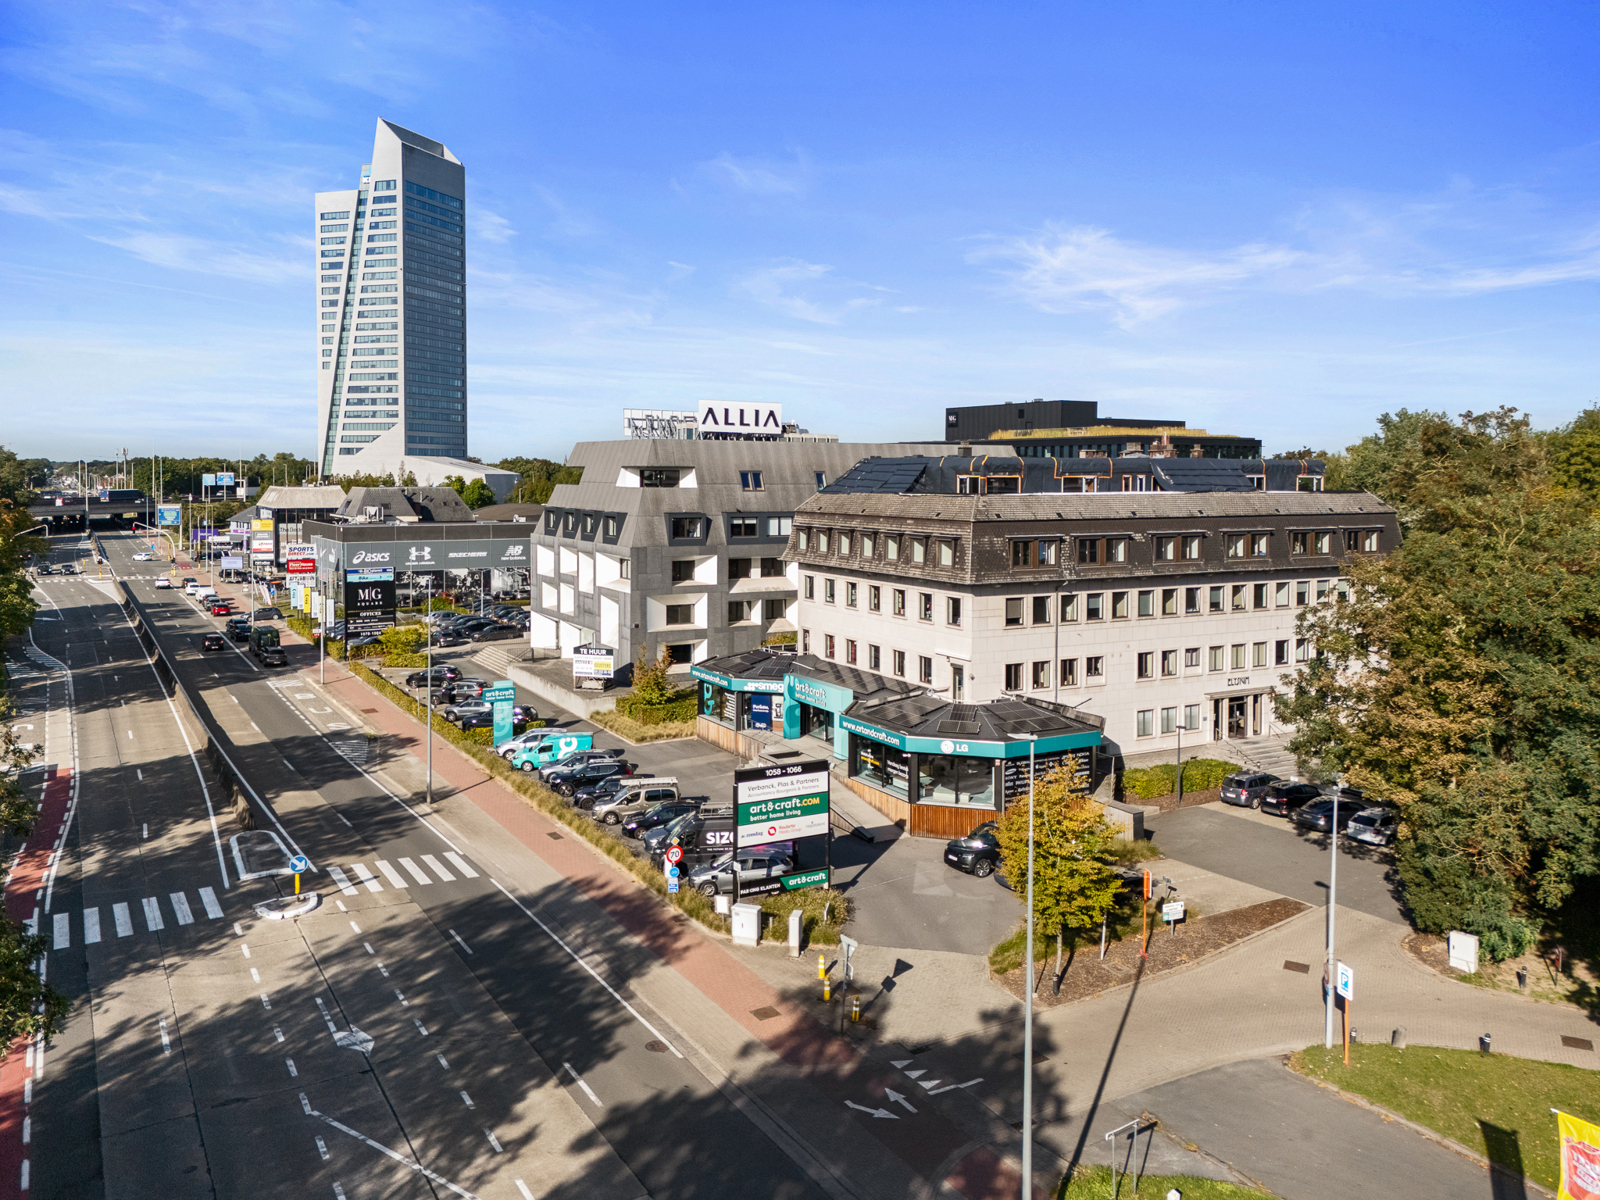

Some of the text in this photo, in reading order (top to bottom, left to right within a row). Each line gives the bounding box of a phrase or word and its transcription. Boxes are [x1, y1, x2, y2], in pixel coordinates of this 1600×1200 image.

[702, 407, 780, 428] ALLIA
[760, 682, 784, 693] smeg
[795, 683, 826, 698] art&craft
[842, 720, 900, 746] www.artandcraft.com
[957, 744, 968, 752] LG
[787, 766, 802, 774] 1066
[789, 873, 826, 886] art&craft
